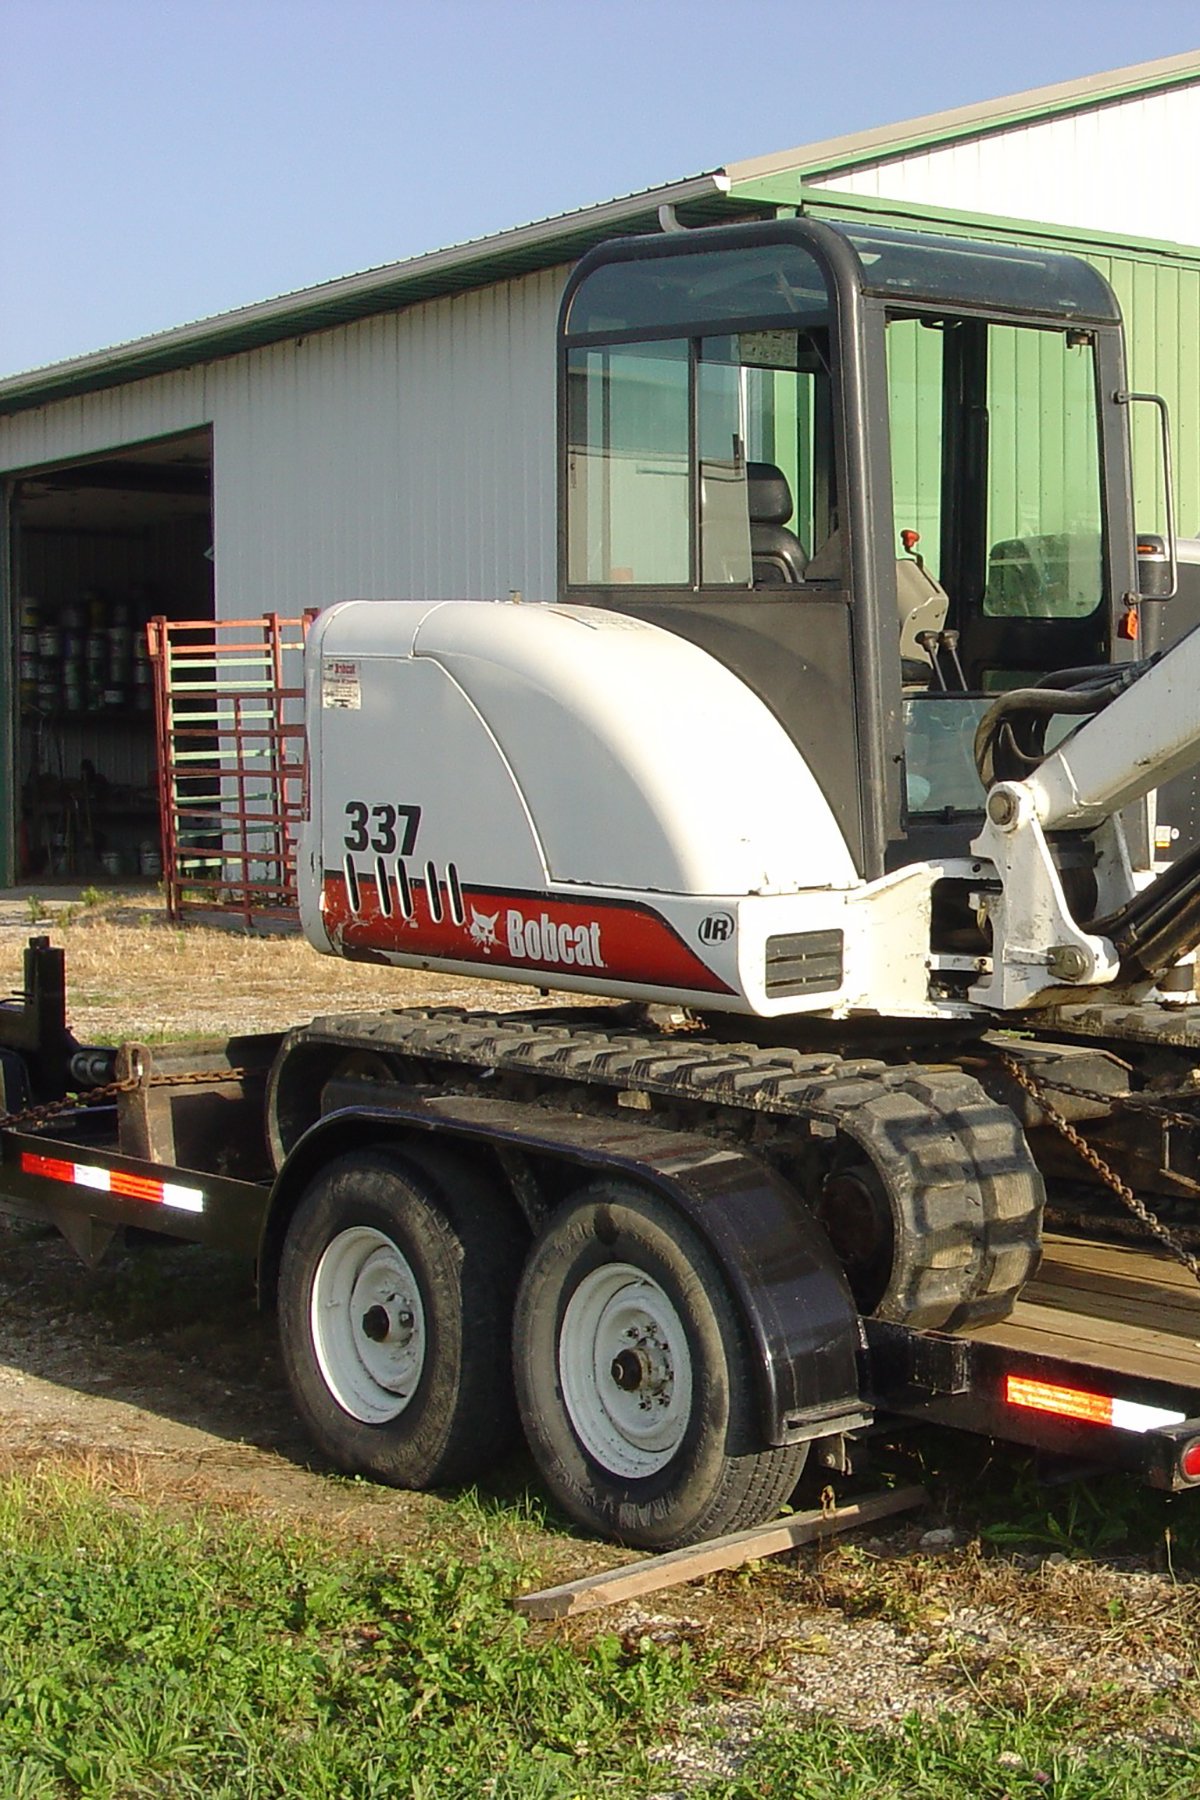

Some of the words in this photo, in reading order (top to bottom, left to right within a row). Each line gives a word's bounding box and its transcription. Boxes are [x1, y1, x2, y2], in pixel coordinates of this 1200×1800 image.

[344, 801, 421, 856] 337
[507, 909, 605, 968] Bobcat
[701, 915, 730, 942] IR
